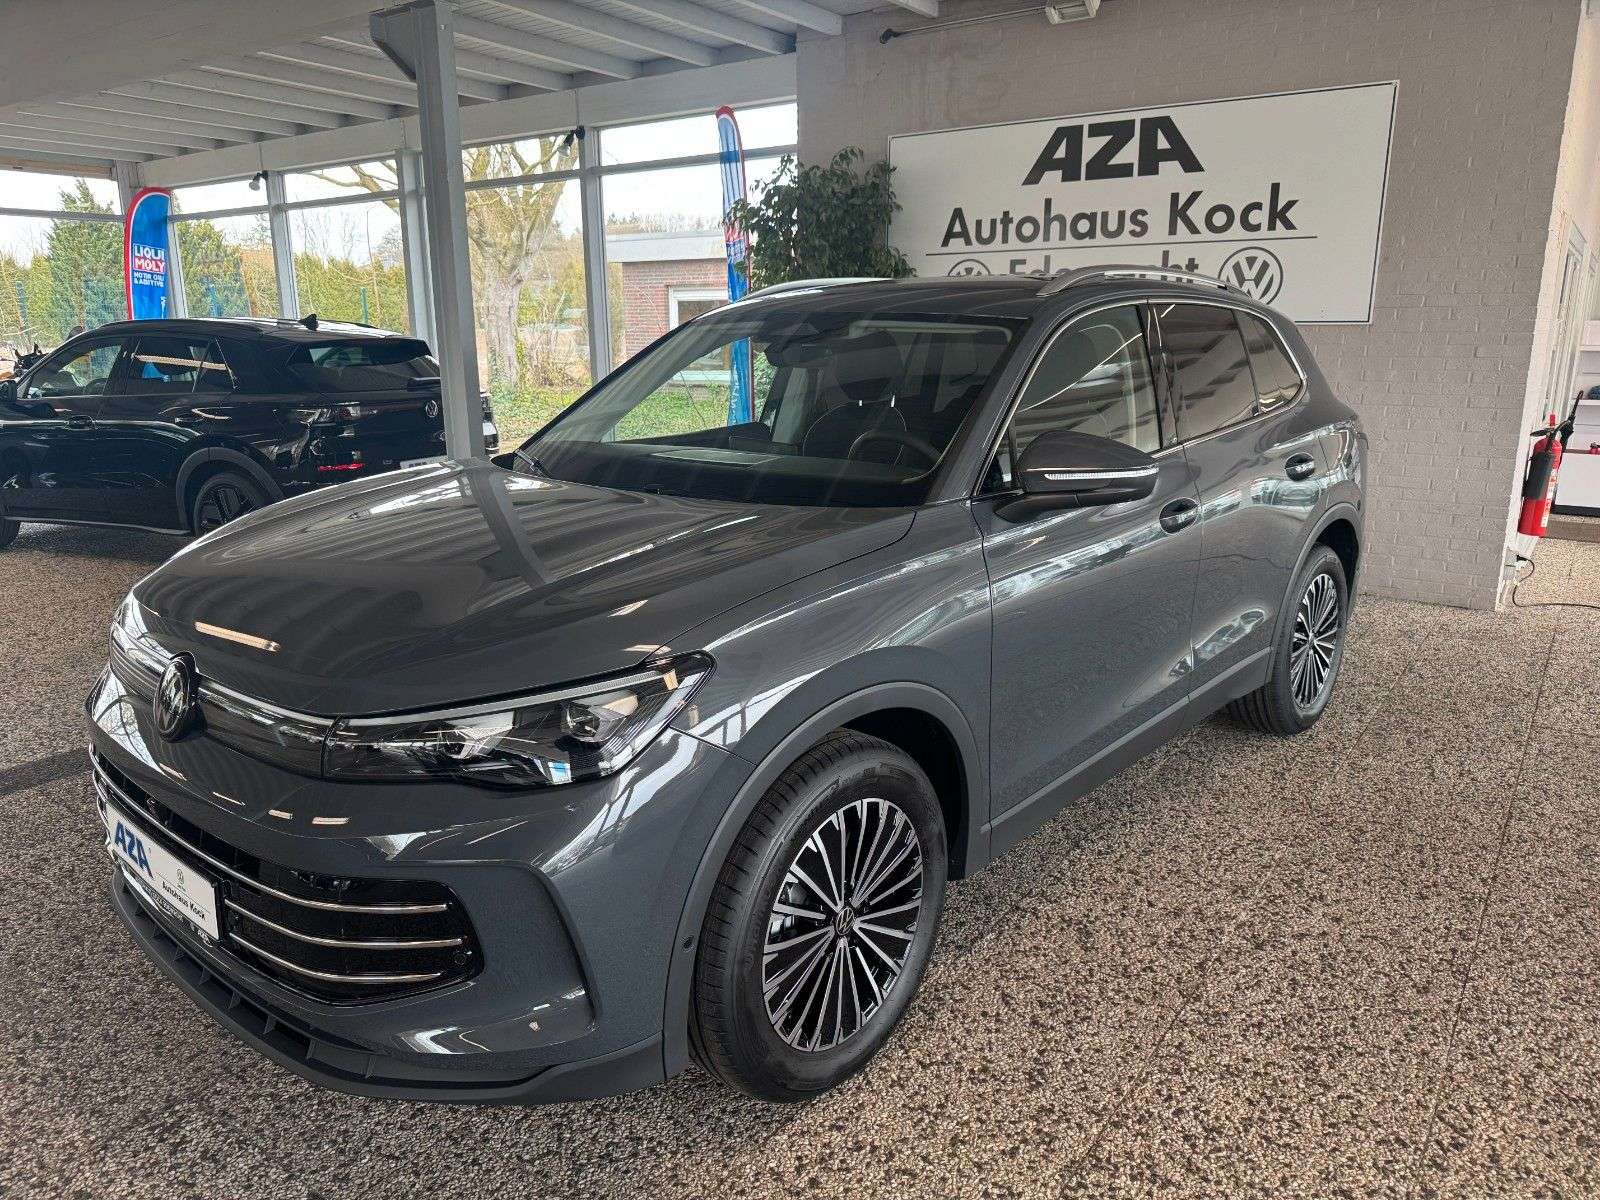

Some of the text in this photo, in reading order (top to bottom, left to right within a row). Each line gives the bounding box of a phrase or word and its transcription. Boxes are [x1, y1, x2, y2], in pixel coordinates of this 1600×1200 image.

[1021, 115, 1205, 186] AZA
[941, 183, 1299, 248] Autohaus Kock
[134, 244, 165, 261] LIQUI
[134, 256, 165, 272] MOLY
[115, 821, 154, 879] AZA
